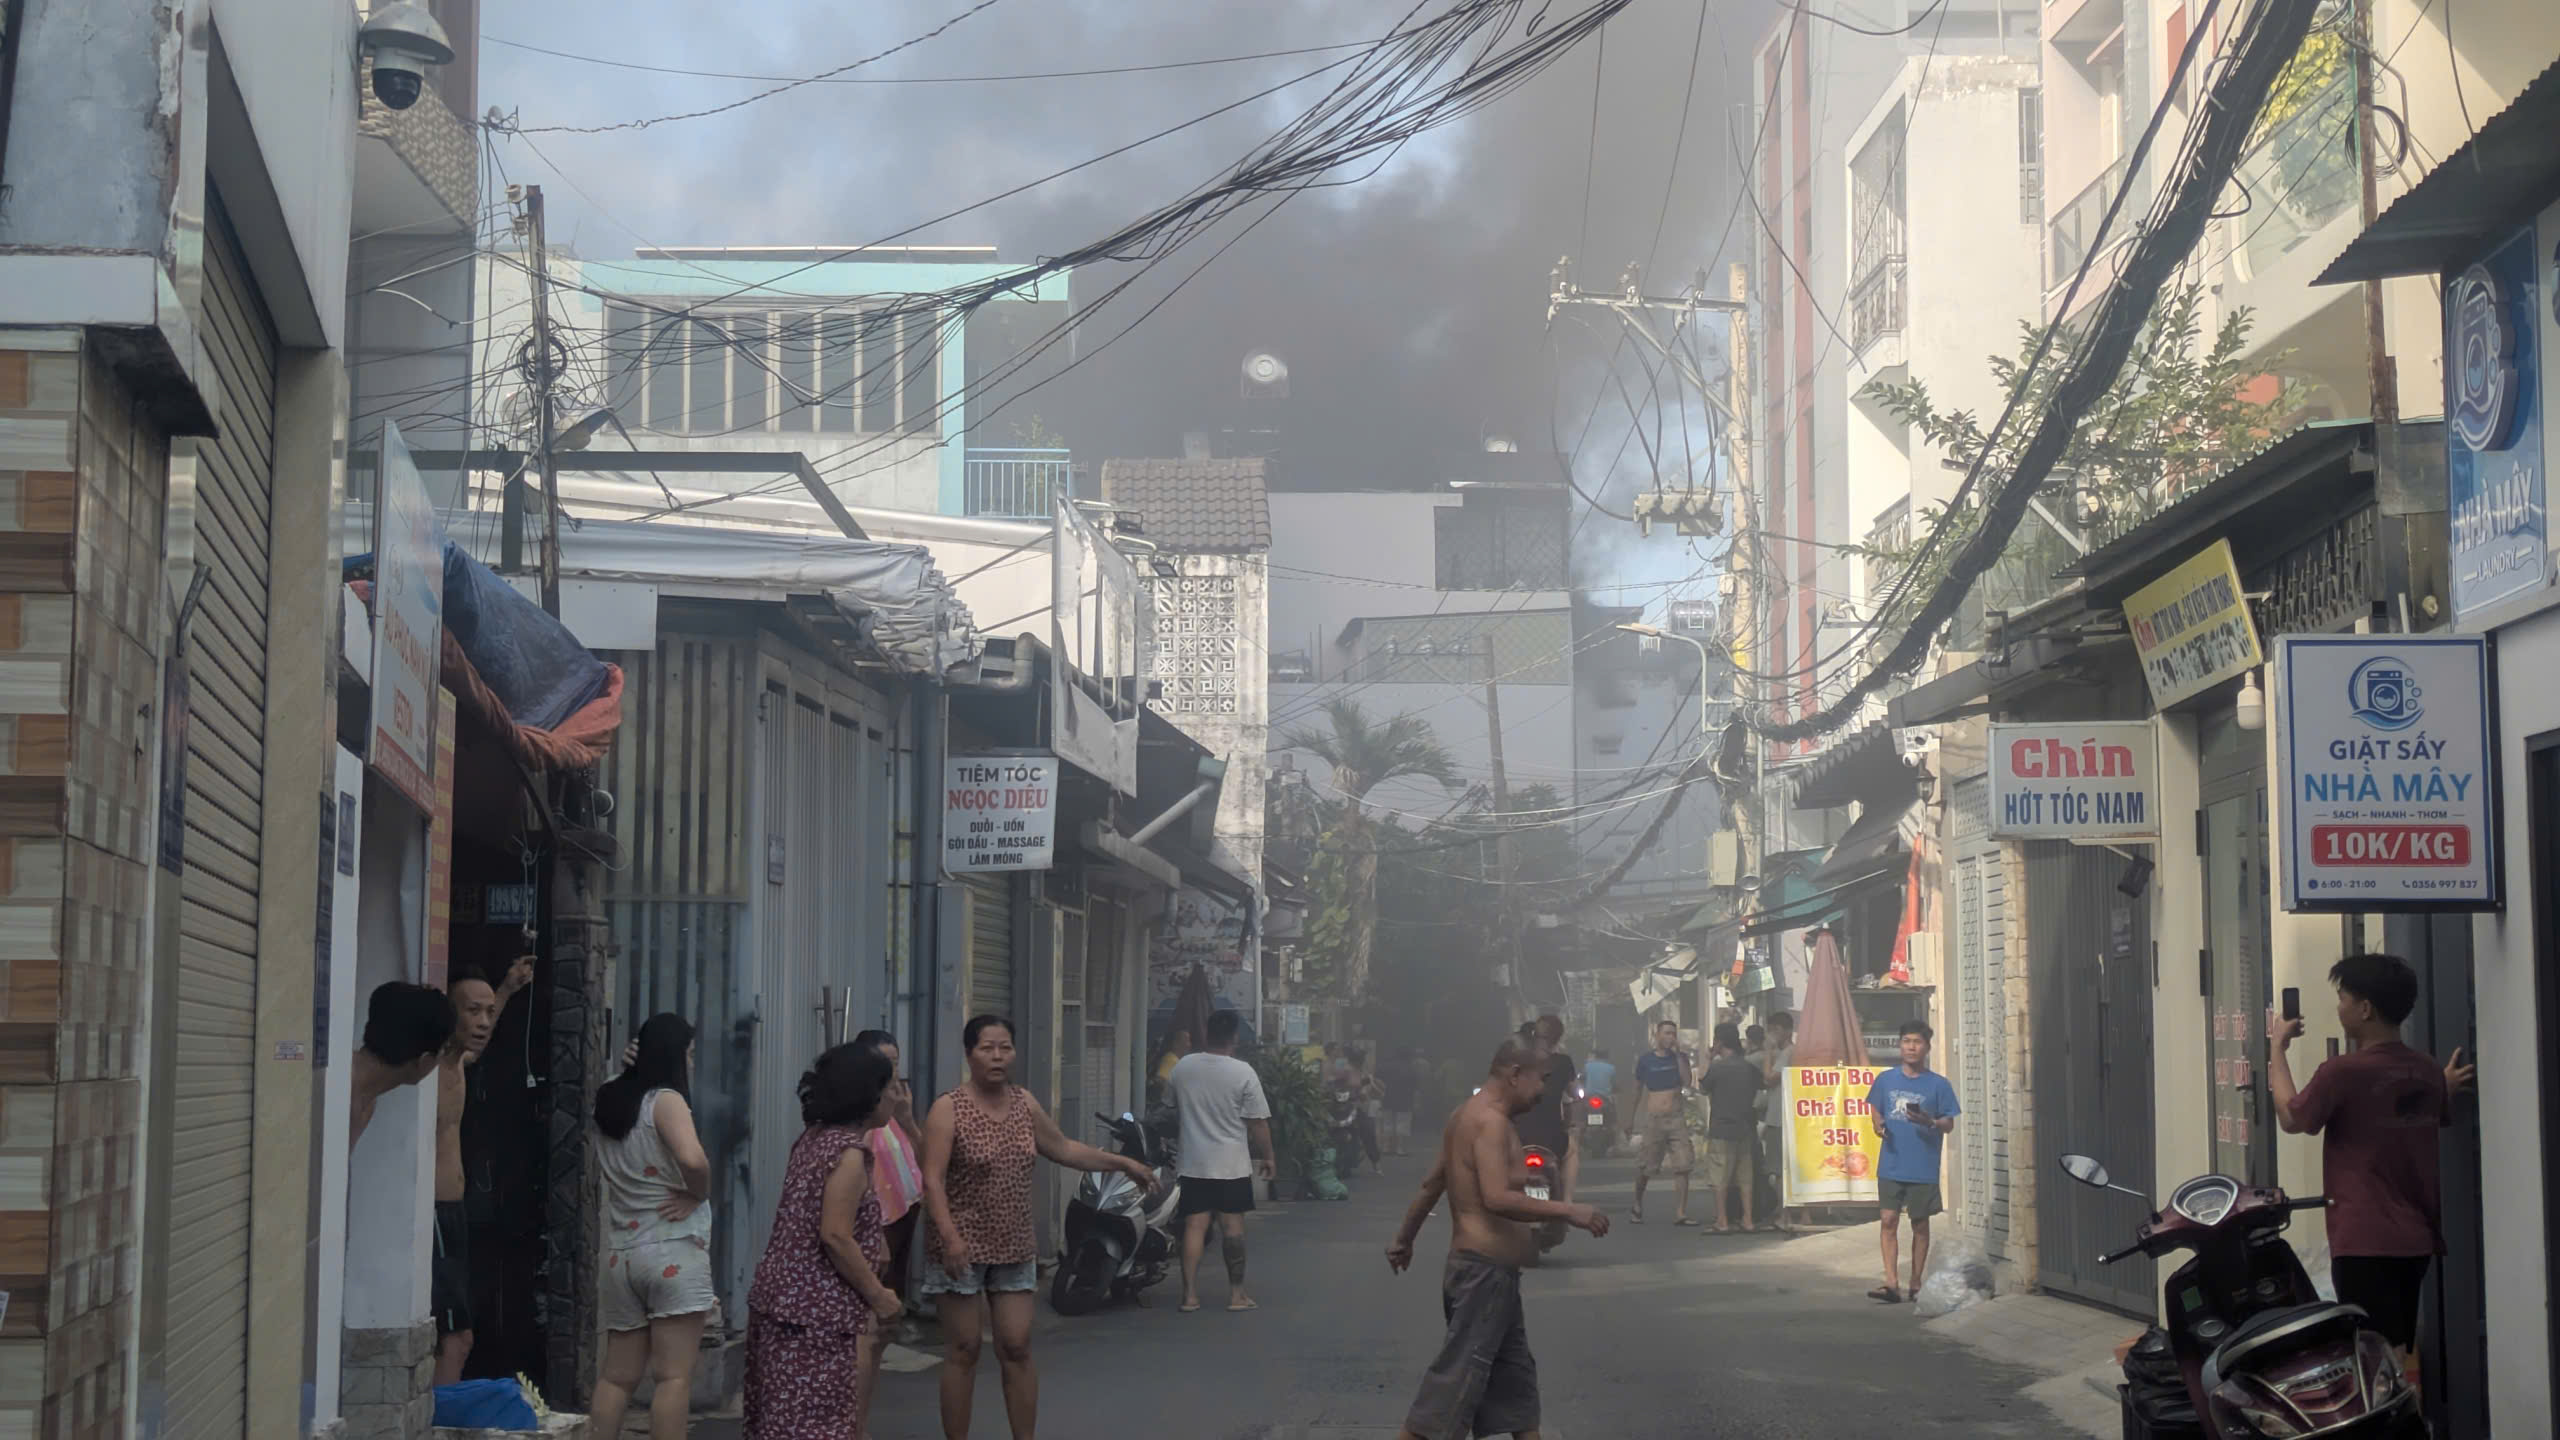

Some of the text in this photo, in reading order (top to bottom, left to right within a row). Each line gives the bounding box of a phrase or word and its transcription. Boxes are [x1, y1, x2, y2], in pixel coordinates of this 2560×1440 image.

[2458, 460, 2533, 553] NHÀ MÂY
[2478, 545, 2517, 580] LAUNDRY
[2011, 737, 2135, 778] Chín
[2329, 731, 2447, 765] GIẶT SẤY
[957, 763, 1042, 787] TIỆM TÓC
[2304, 766, 2473, 802] NHÀ MÂY
[948, 784, 1049, 815] NGỌC DIỆU
[2005, 786, 2144, 825] HỚT TÓC NAM
[2333, 811, 2359, 821] SẠCH
[2370, 811, 2407, 819] NHANH
[2417, 810, 2448, 819] THƠM
[997, 836, 1046, 849] MASSAGE
[992, 851, 1023, 865] MÓNG
[2321, 880, 2342, 889] 6:00
[2350, 880, 2376, 889] 21:00
[2412, 880, 2478, 889] 0356 997 837
[1801, 1069, 1875, 1086] Bún Bò
[1796, 1097, 1836, 1117] Chả
[1843, 1099, 1872, 1116] Gh
[1822, 1128, 1860, 1146] 35k
